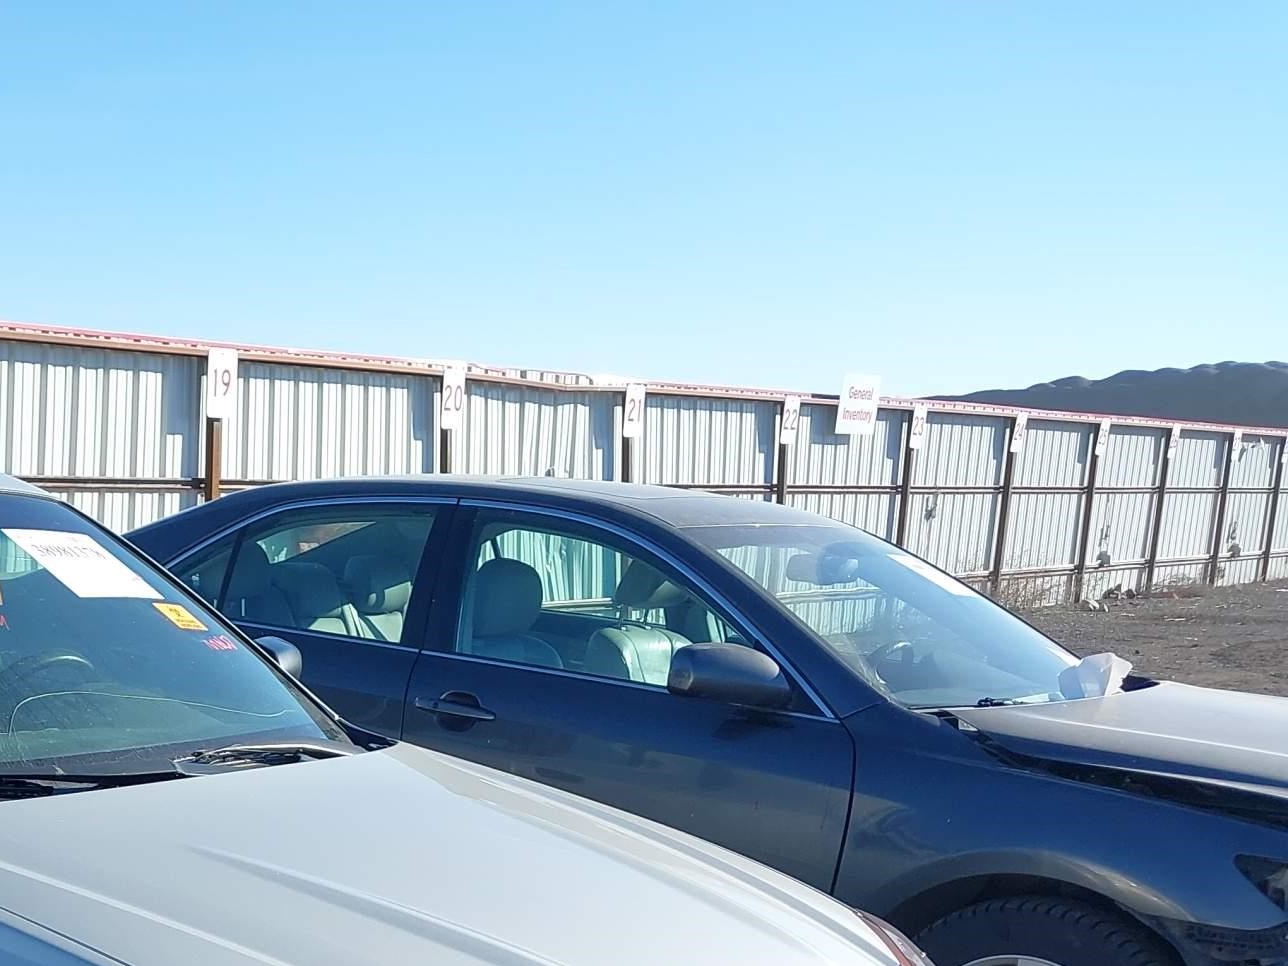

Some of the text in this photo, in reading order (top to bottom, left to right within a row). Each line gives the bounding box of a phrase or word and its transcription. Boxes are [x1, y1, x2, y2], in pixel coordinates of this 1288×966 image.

[213, 368, 231, 397] 19
[848, 386, 874, 400] General
[443, 385, 463, 411] 20
[627, 398, 642, 423] 21
[783, 408, 798, 430] 22
[842, 407, 874, 424] Inventory
[912, 416, 925, 436] 23
